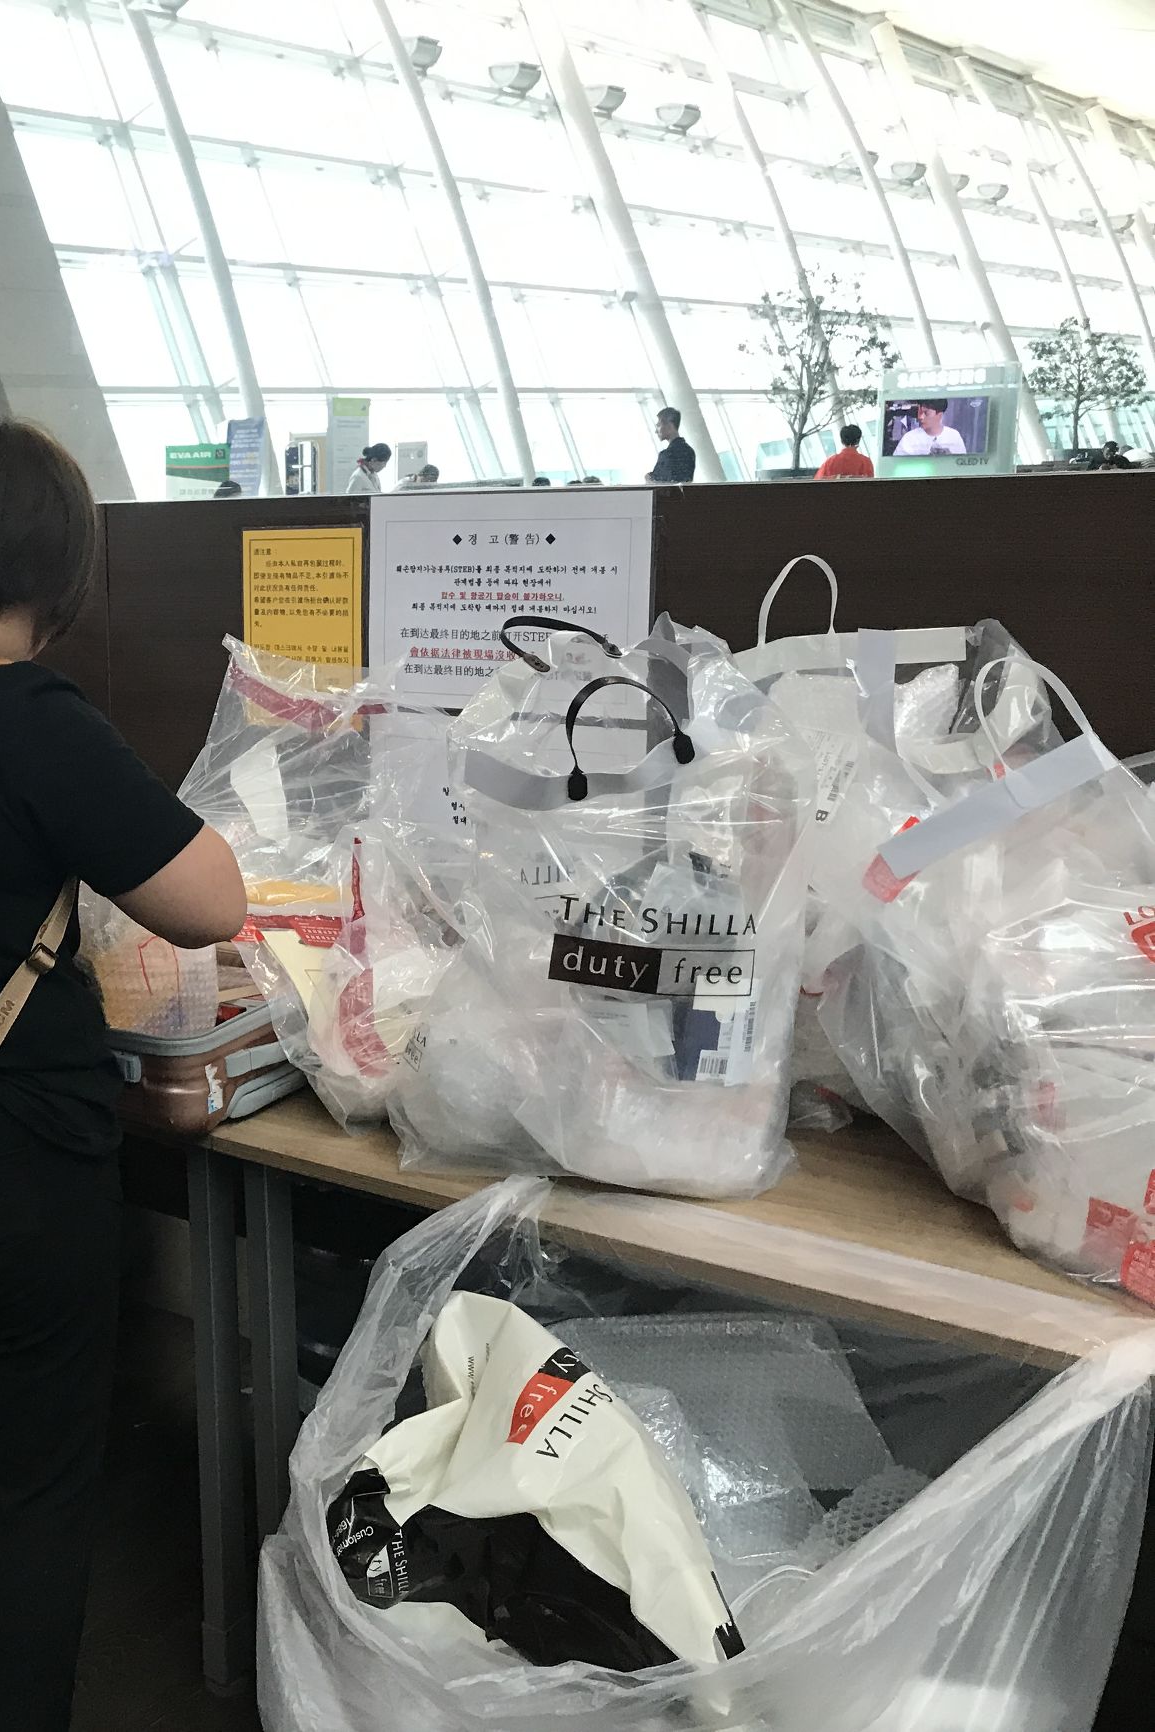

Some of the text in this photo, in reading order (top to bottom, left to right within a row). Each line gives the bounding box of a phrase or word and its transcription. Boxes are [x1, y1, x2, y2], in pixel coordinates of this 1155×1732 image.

[897, 368, 987, 389] SAMSUNG
[169, 451, 212, 460] EVA AIR
[468, 533, 478, 546] 경
[404, 663, 499, 678] 在到达最终目的地之
[560, 895, 758, 936] THE SHILLA
[562, 945, 744, 988] duty free
[535, 1383, 614, 1459] SHILLA
[336, 1525, 375, 1558] Customer
[391, 1528, 405, 1559] THE
